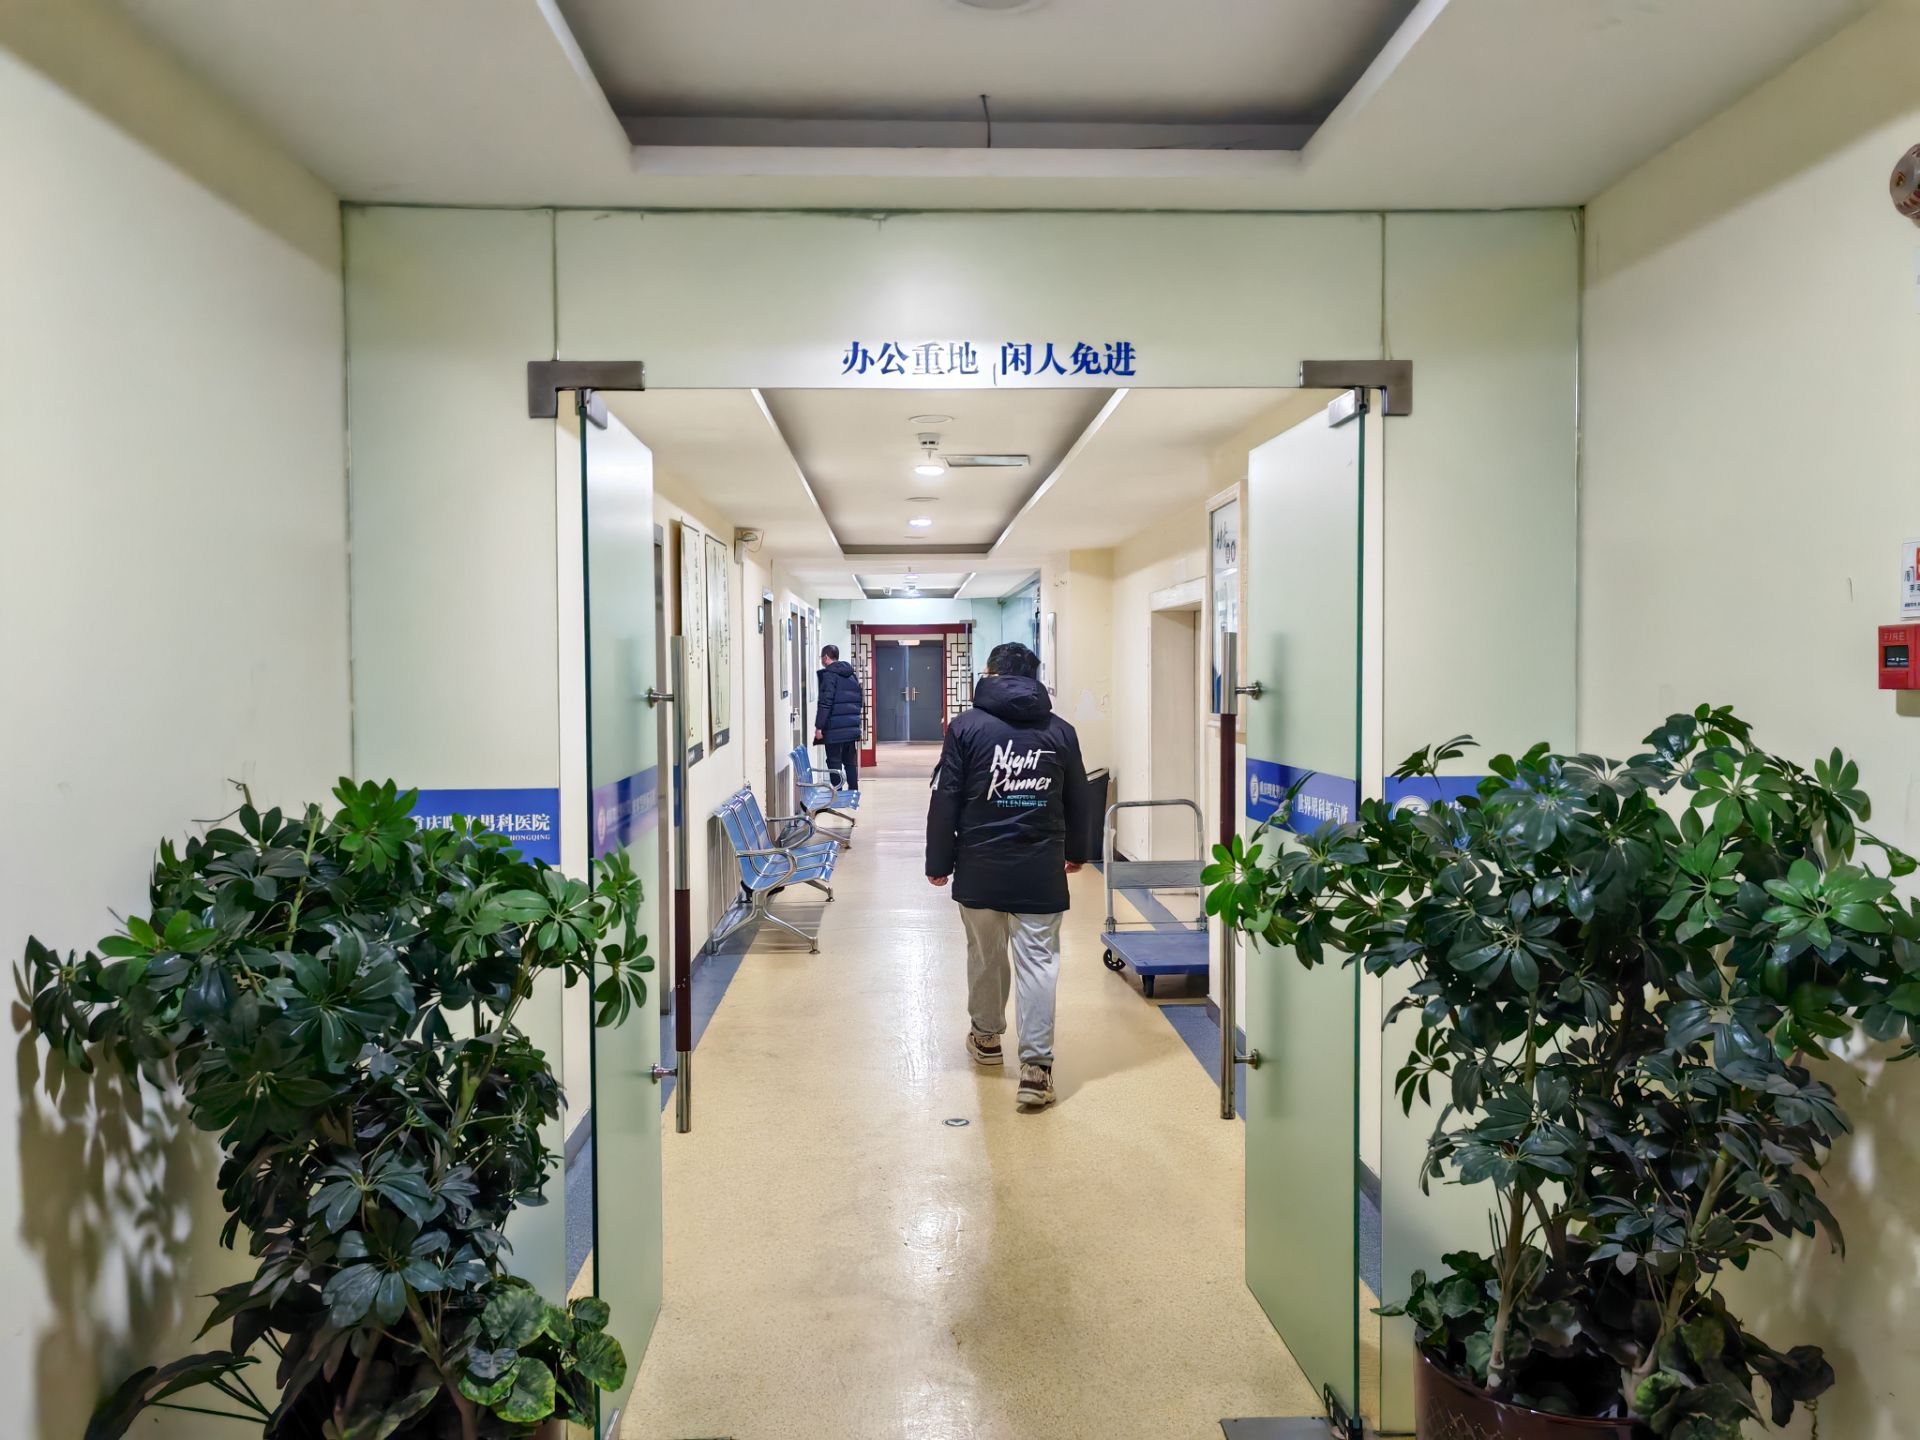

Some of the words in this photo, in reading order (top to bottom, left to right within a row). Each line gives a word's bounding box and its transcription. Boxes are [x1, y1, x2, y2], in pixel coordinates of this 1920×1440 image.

[841, 341, 979, 376] 办公重地
[1001, 341, 1137, 376] 闲人免进
[990, 739, 1056, 776] Night
[987, 766, 1052, 801] Runner
[508, 833, 551, 842] HONGQING
